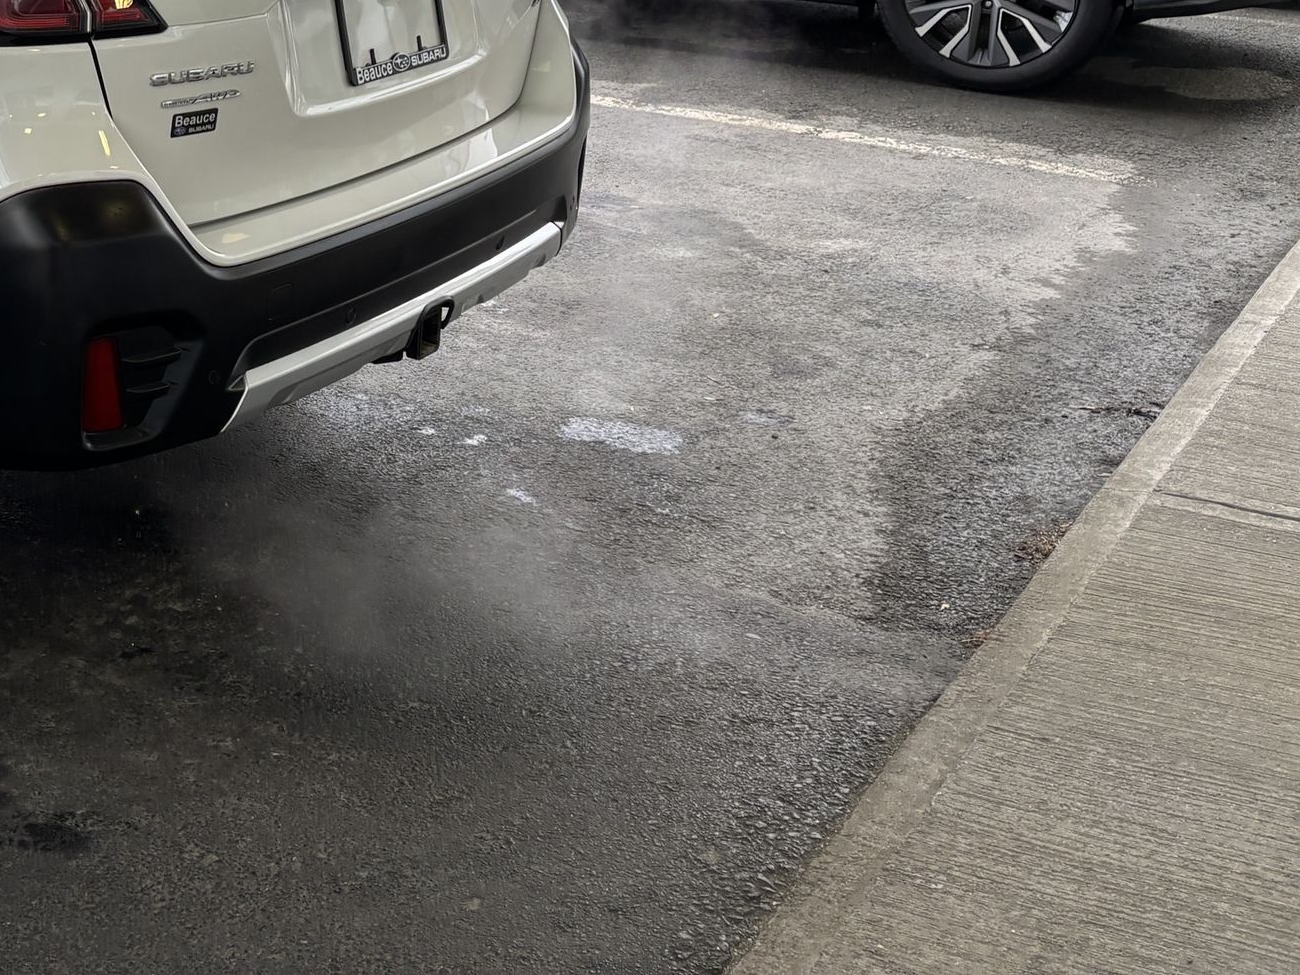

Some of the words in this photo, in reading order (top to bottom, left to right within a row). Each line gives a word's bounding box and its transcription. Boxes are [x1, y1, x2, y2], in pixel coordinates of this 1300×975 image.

[149, 60, 255, 87] SUBARU
[356, 62, 393, 85] Beauce
[411, 46, 447, 66] SUBARU
[174, 111, 216, 127] Beauce
[188, 124, 215, 134] SUBARU
